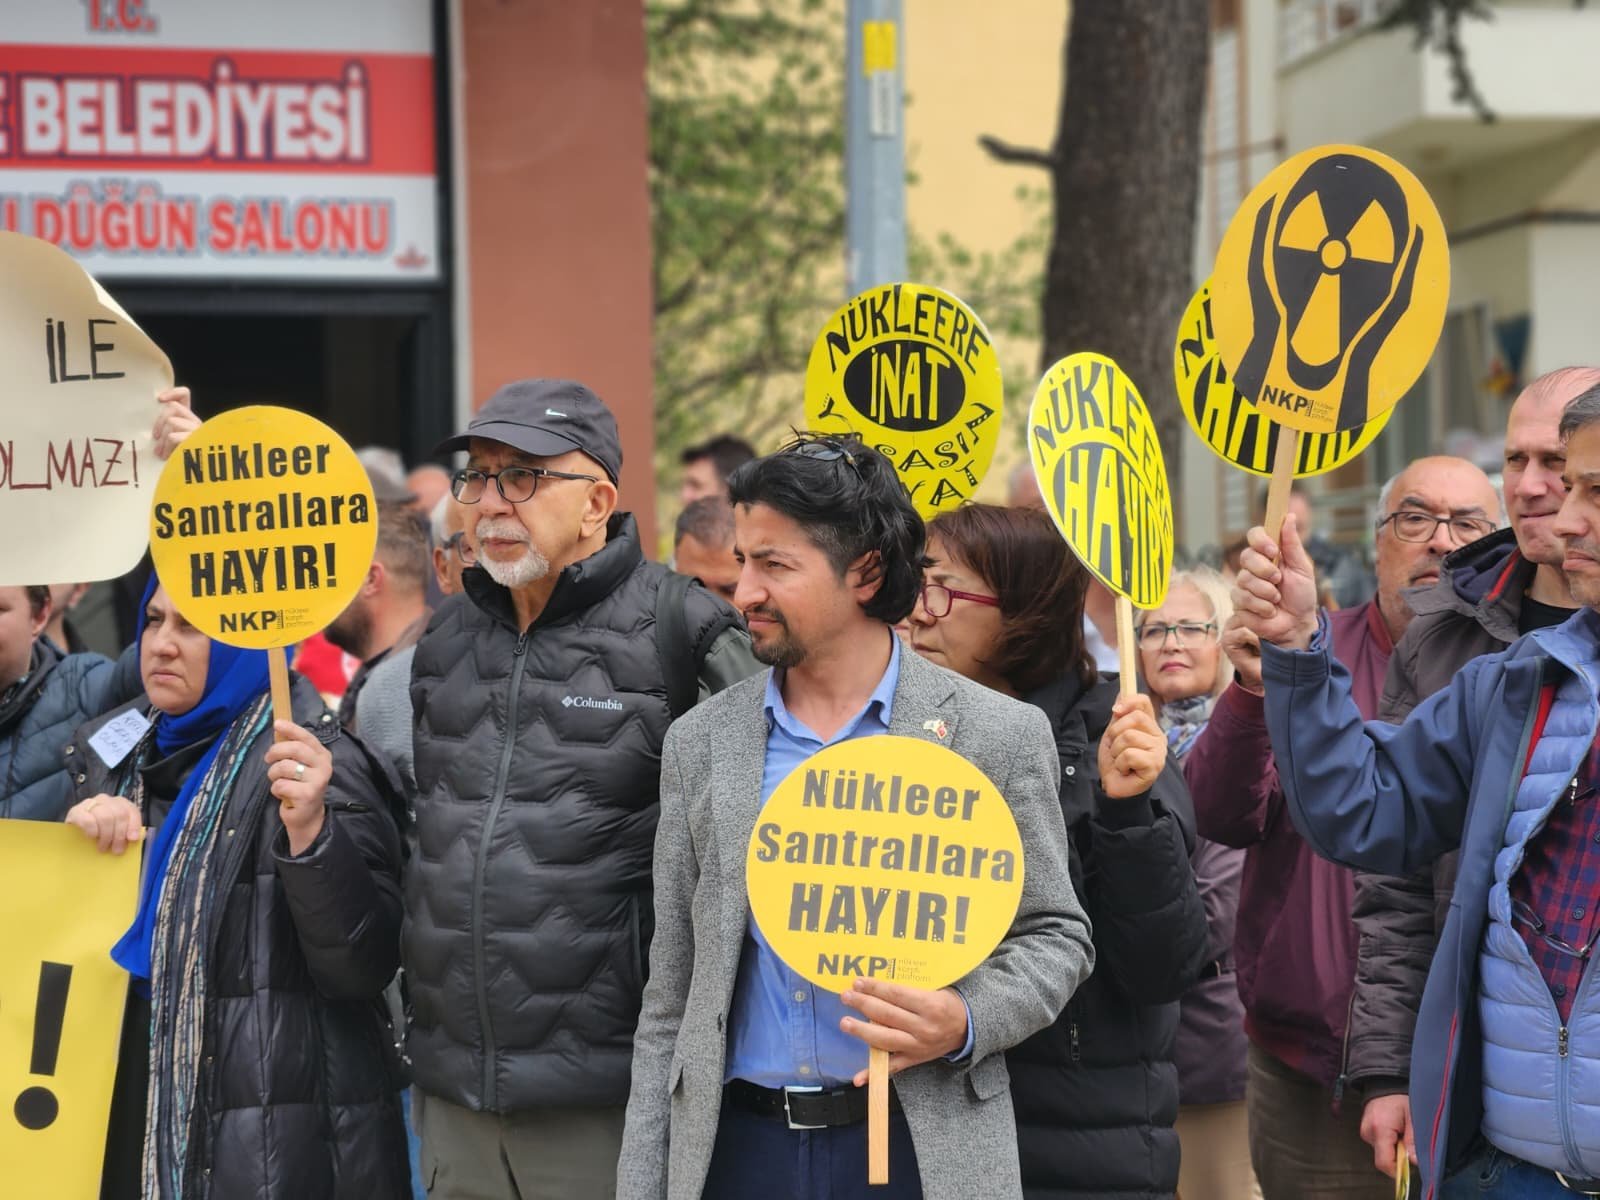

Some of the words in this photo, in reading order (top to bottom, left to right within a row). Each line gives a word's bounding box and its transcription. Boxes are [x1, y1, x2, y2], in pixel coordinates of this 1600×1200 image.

[21, 60, 368, 160] BELEDİYESİ
[34, 183, 197, 252] DÜĞÜN
[208, 200, 390, 255] SALONU
[45, 318, 125, 384] İLE
[826, 284, 990, 375] NÜKLEERE
[869, 342, 951, 425] İNAT
[1262, 384, 1308, 413] NKP
[184, 443, 330, 485] Nükleer
[155, 492, 369, 539] Santrallara
[1063, 447, 1162, 604] HAYIR
[190, 542, 337, 598] HAYIR!
[219, 611, 277, 632] NKP
[573, 696, 623, 711] Columbia
[802, 768, 980, 821] Nükleer
[756, 822, 1015, 882] Santrallara
[788, 882, 971, 945] HAYIR!
[816, 952, 889, 978] NKP
